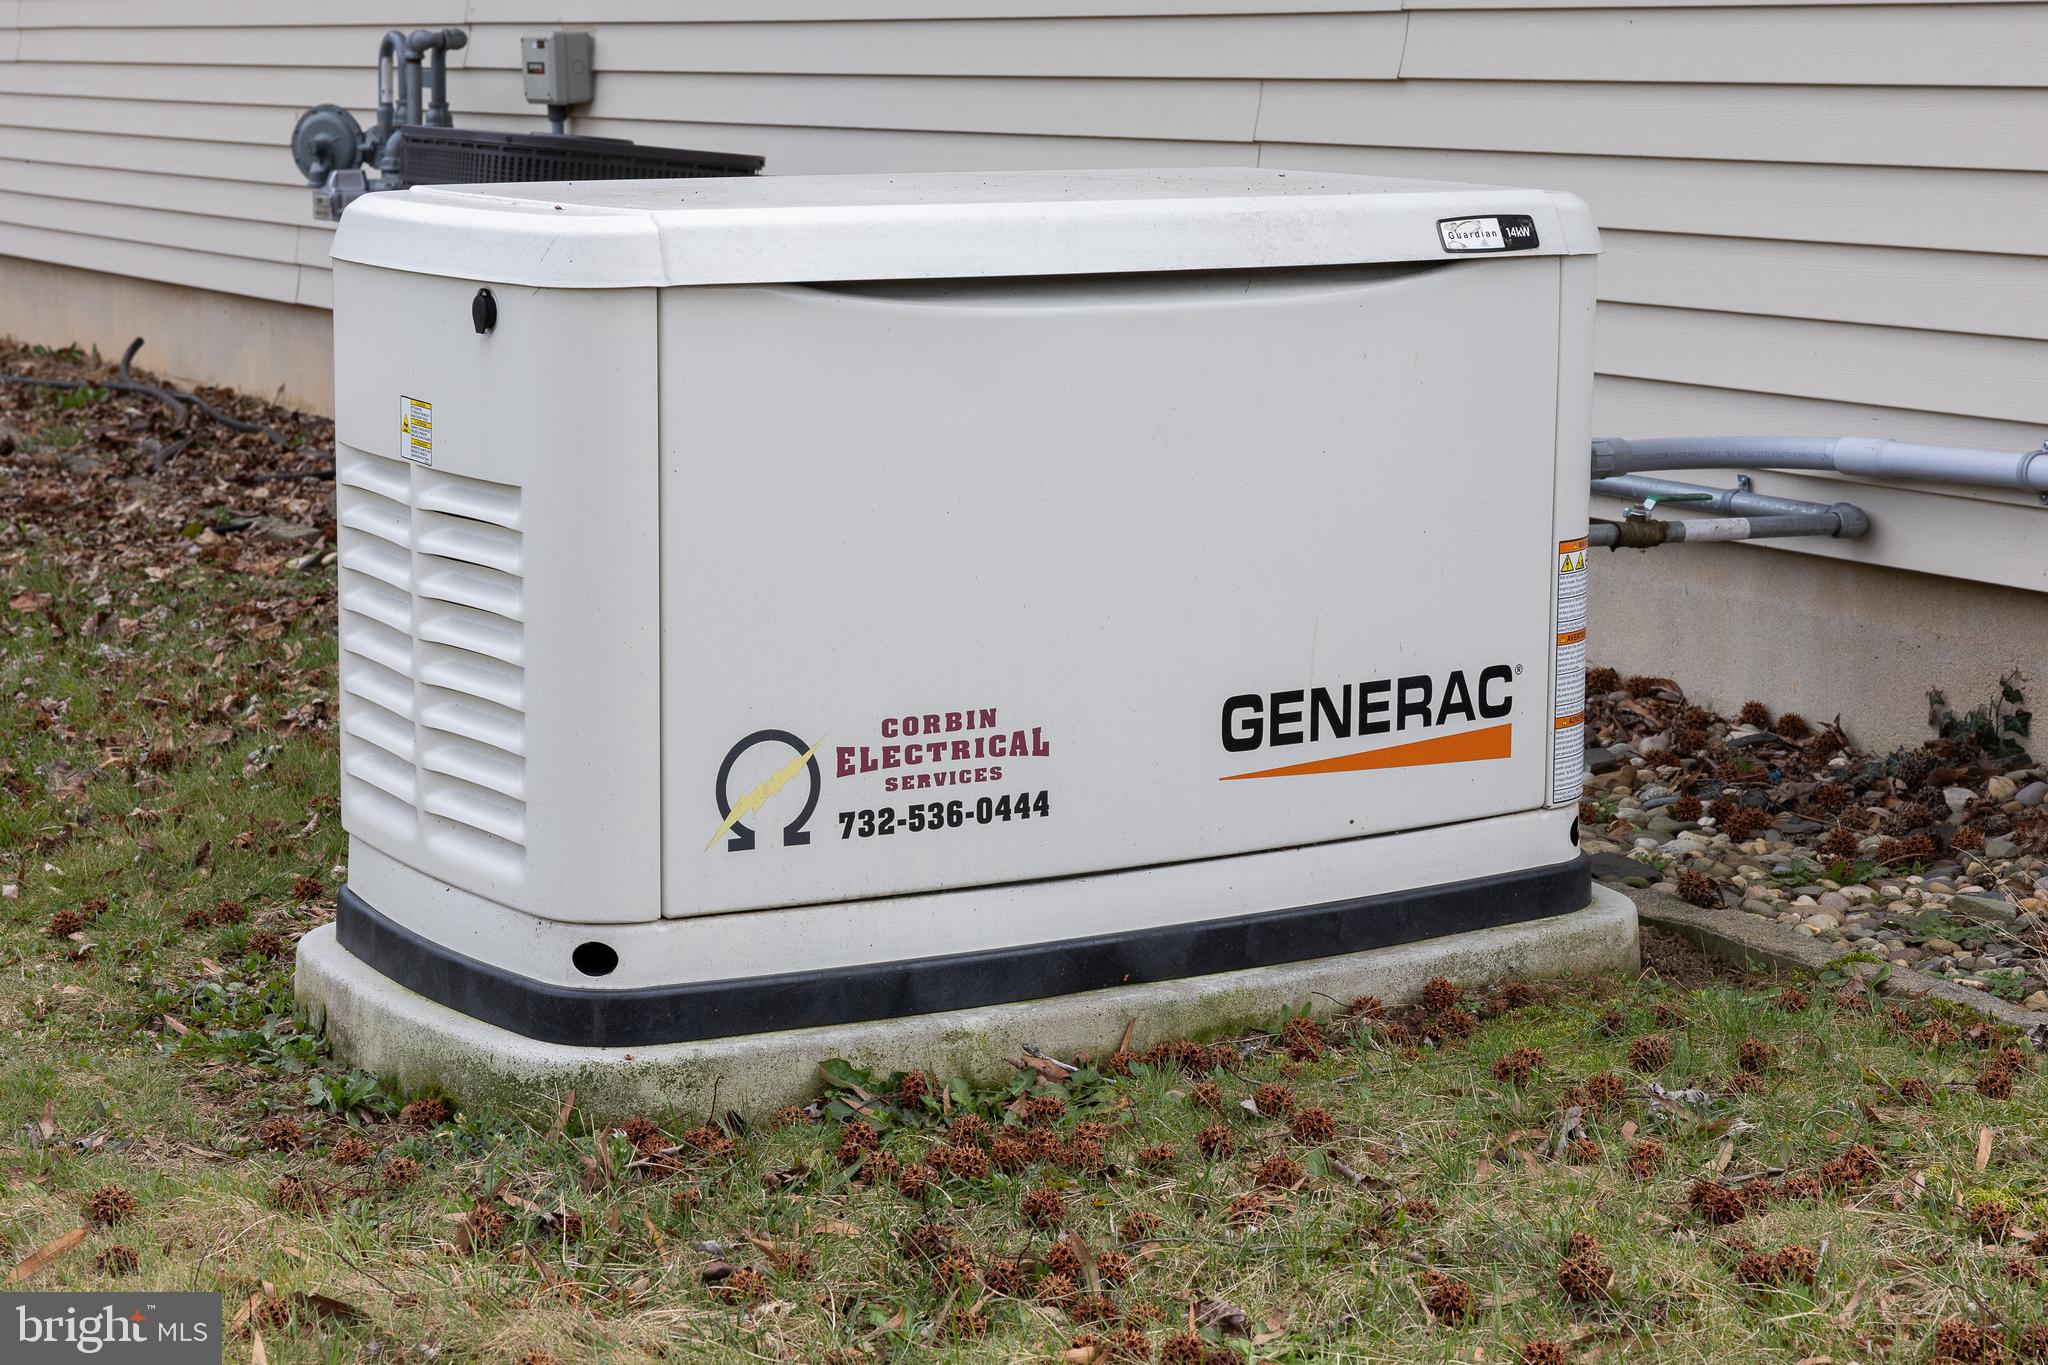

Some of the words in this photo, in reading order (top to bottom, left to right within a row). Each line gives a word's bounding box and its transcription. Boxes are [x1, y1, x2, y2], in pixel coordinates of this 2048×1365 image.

[1448, 229, 1498, 240] Guardian
[1505, 226, 1531, 238] 14kW
[881, 708, 998, 738] CORBIN
[836, 727, 1051, 778] ELECTRICAL
[885, 766, 1004, 792] SERVICES
[838, 790, 1051, 840] 732-536-0444
